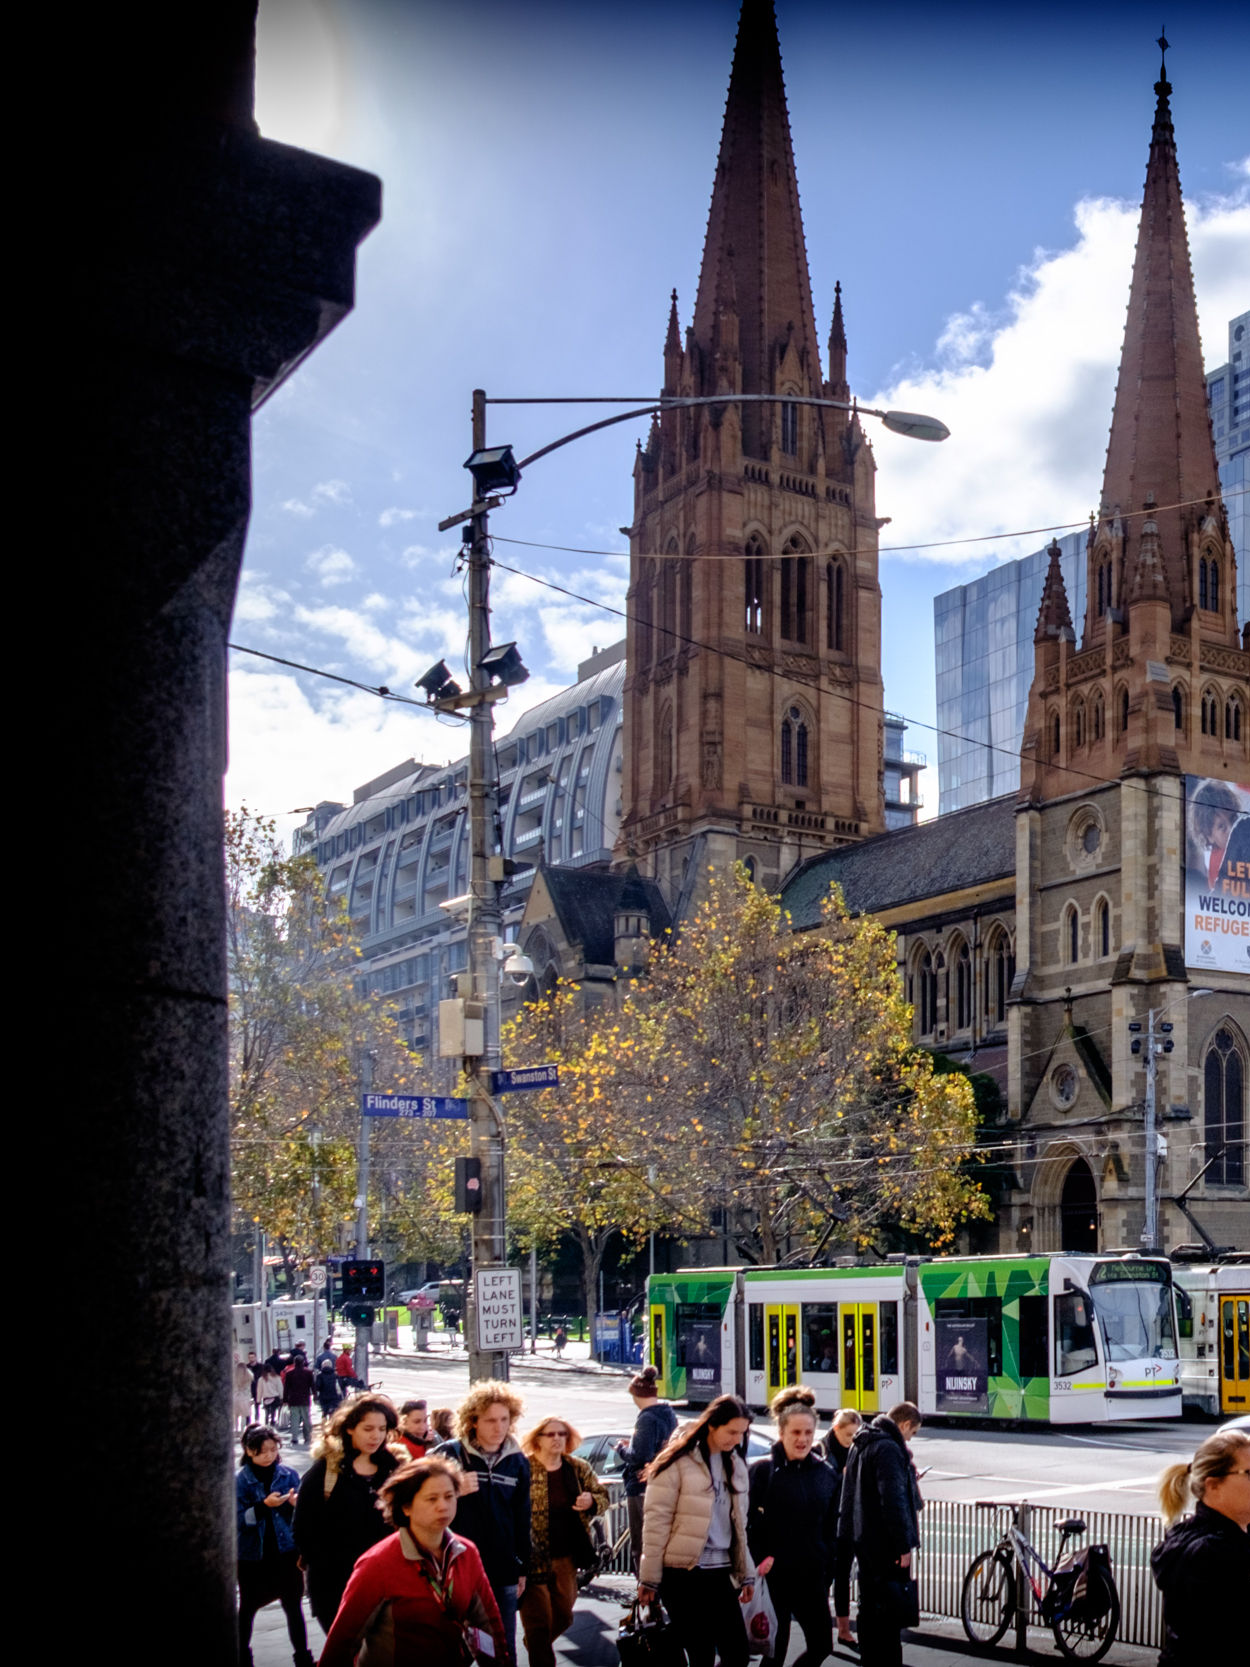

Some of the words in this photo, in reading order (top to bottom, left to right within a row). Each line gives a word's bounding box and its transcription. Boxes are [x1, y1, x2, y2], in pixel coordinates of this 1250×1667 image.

[510, 1070, 547, 1085] Swanston
[547, 1068, 557, 1081] St
[367, 1096, 418, 1110] Flinders
[422, 1097, 436, 1110] St
[313, 1272, 324, 1280] 30
[483, 1276, 513, 1287] LEFT
[482, 1290, 515, 1301] LANE
[482, 1304, 516, 1315] MUST
[483, 1318, 517, 1330] TURN
[485, 1333, 515, 1344] LEFT
[1053, 1381, 1072, 1391] 3532
